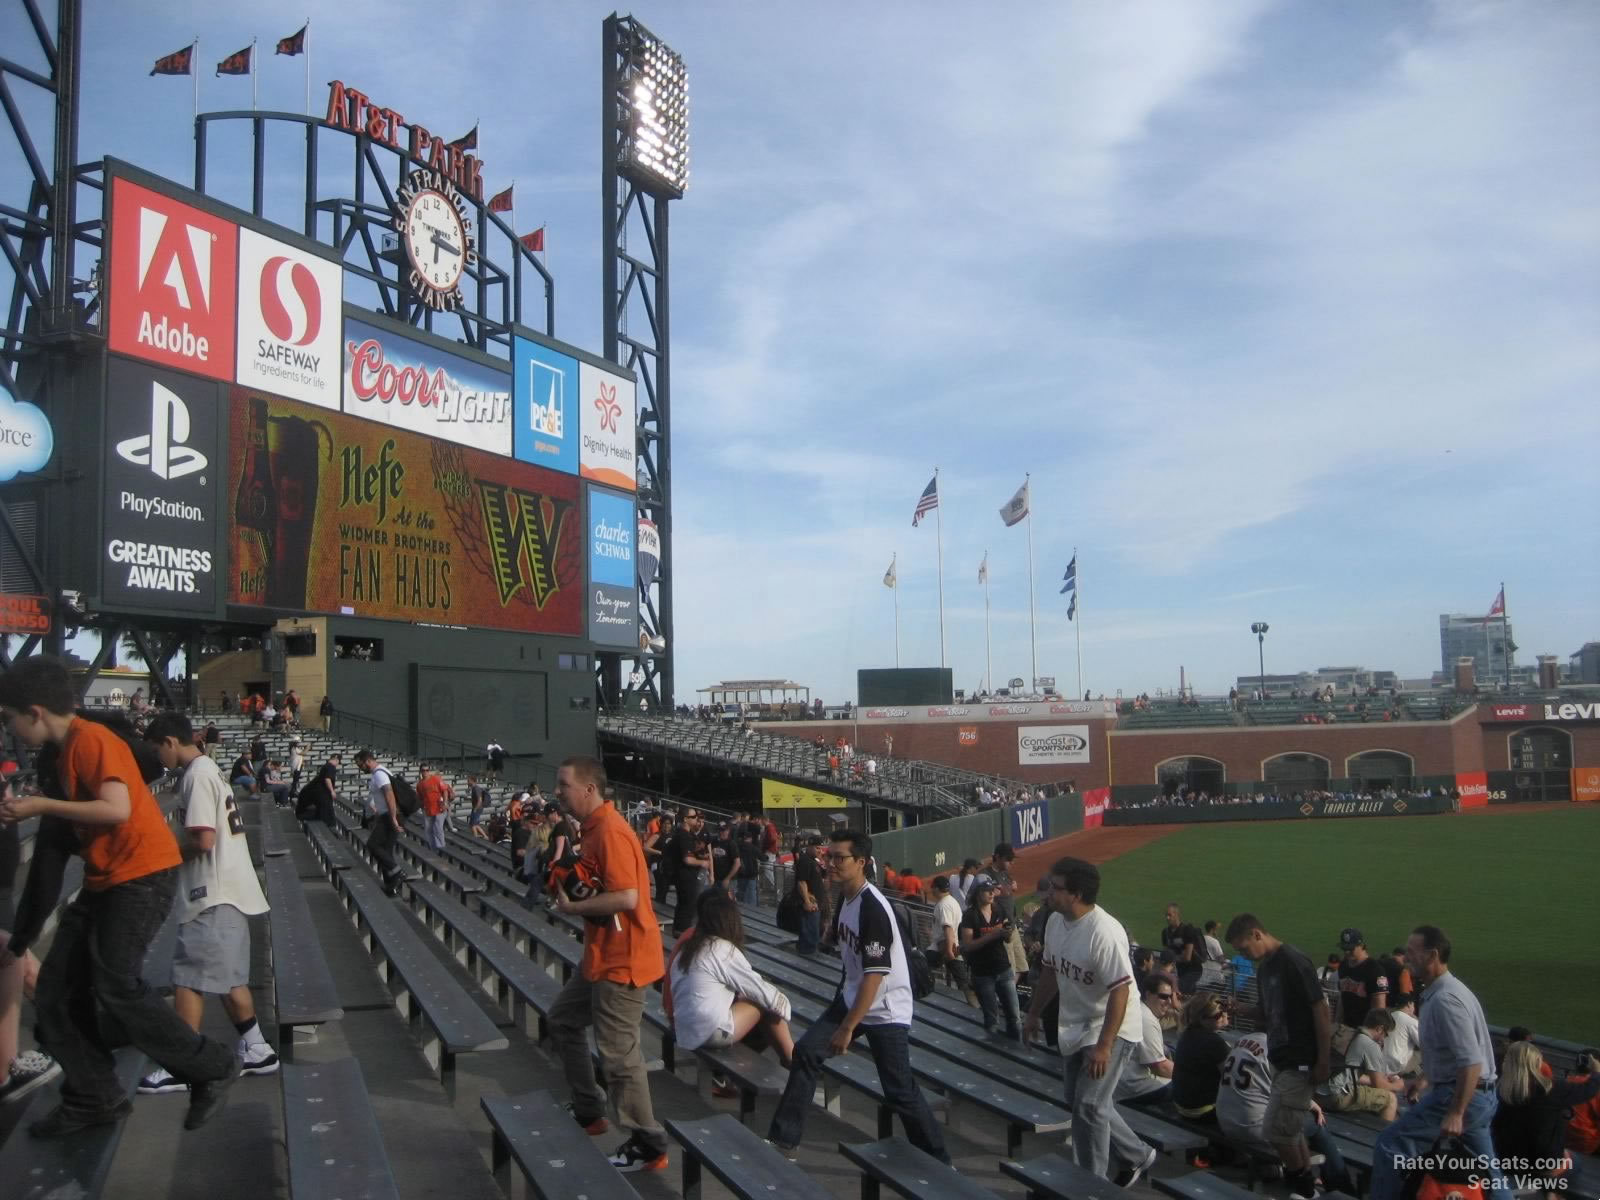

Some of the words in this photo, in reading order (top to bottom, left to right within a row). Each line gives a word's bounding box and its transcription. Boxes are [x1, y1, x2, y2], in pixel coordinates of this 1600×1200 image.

[325, 80, 404, 148] AT&T
[409, 124, 484, 201] PARK
[433, 199, 441, 211] 12
[410, 270, 464, 312] GIANTS
[138, 311, 209, 361] Adobe
[258, 339, 320, 373] SAFEWAY
[253, 360, 299, 383] Ingredients
[300, 373, 312, 384] for
[313, 377, 325, 389] life
[348, 339, 446, 408] Coors
[437, 391, 510, 423] LIGHT
[531, 402, 562, 436] PG&E
[583, 435, 609, 457] Dignity
[609, 446, 632, 461] Health
[339, 439, 405, 525] Hefe
[121, 491, 202, 521] PlayStation
[393, 505, 411, 526] At
[416, 510, 435, 530] the
[339, 523, 388, 545] WIDMER
[395, 533, 451, 555] BROTHERS
[595, 518, 630, 544] charles
[108, 540, 211, 572] GREATNESS
[595, 541, 631, 561] SCHWAB
[127, 566, 195, 593] AWAITS
[340, 544, 380, 603] FAN
[396, 553, 451, 610] HAUS
[960, 731, 977, 741] 756
[1323, 802, 1355, 814] TRIPLES
[1358, 801, 1384, 813] ALLEY
[1486, 790, 1507, 800] 365
[1016, 806, 1044, 845] VISA
[864, 944, 886, 953] WORLD
[1221, 1055, 1252, 1091] 25
